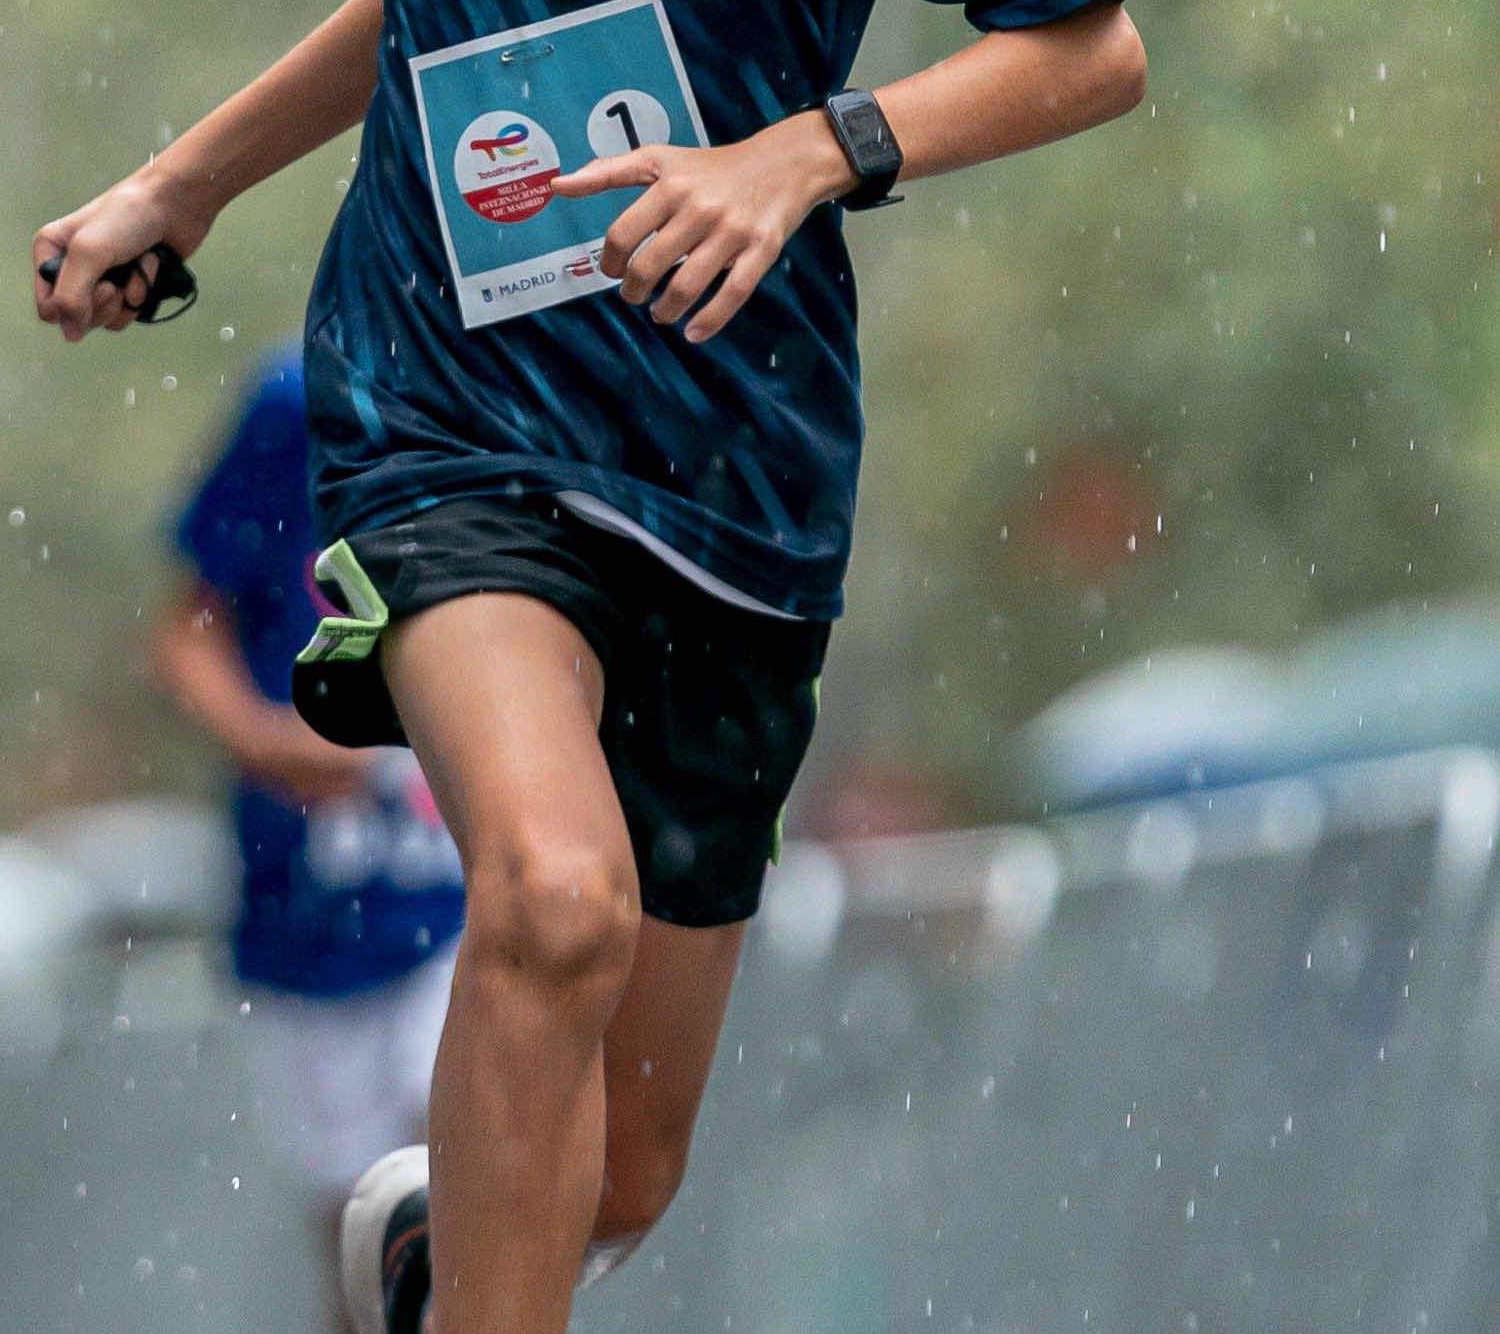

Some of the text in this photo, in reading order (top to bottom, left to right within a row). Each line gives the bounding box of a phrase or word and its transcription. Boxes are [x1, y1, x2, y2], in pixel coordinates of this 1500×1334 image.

[477, 158, 539, 180] TotalEnergies
[491, 196, 545, 218] DE MADRID
[499, 271, 556, 296] MADRID
